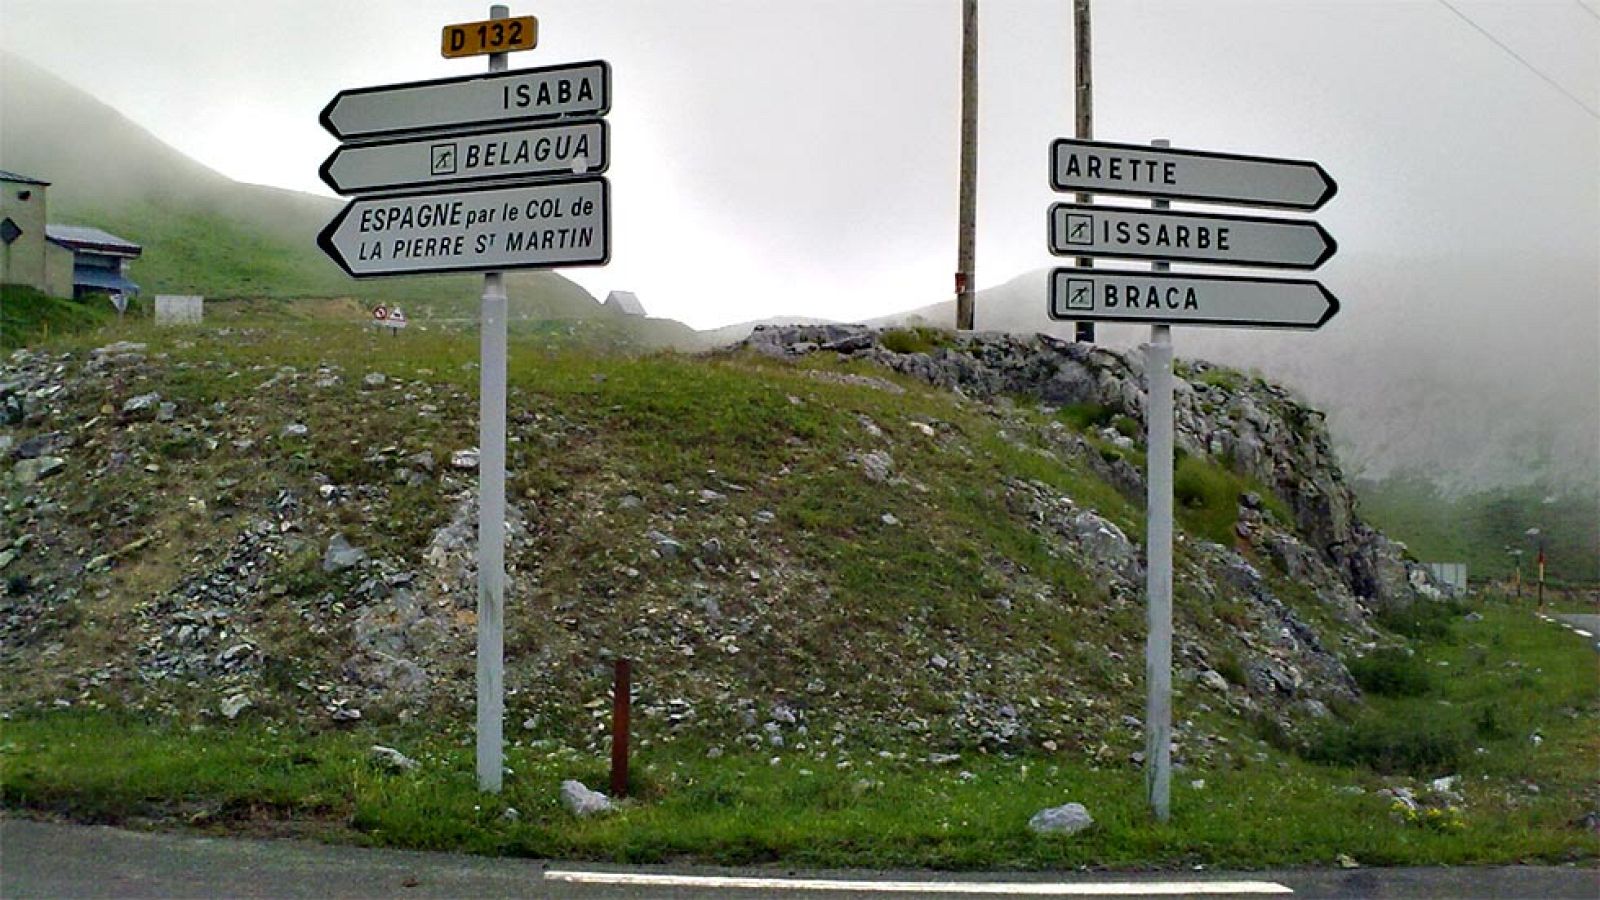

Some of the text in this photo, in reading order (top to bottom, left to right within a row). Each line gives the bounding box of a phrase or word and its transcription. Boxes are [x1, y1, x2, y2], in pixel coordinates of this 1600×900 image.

[451, 21, 523, 51] D 132
[503, 77, 593, 109] ISABA
[466, 134, 589, 168] BELAGUA
[1066, 154, 1177, 184] ARETTE
[360, 197, 593, 232] ESPAGNE par le COL de
[359, 242, 382, 260] LA
[393, 236, 464, 258] PIERRE
[506, 227, 593, 252] MARTIN
[1104, 220, 1230, 250] ISSARBE
[1104, 284, 1198, 310] BRACA
